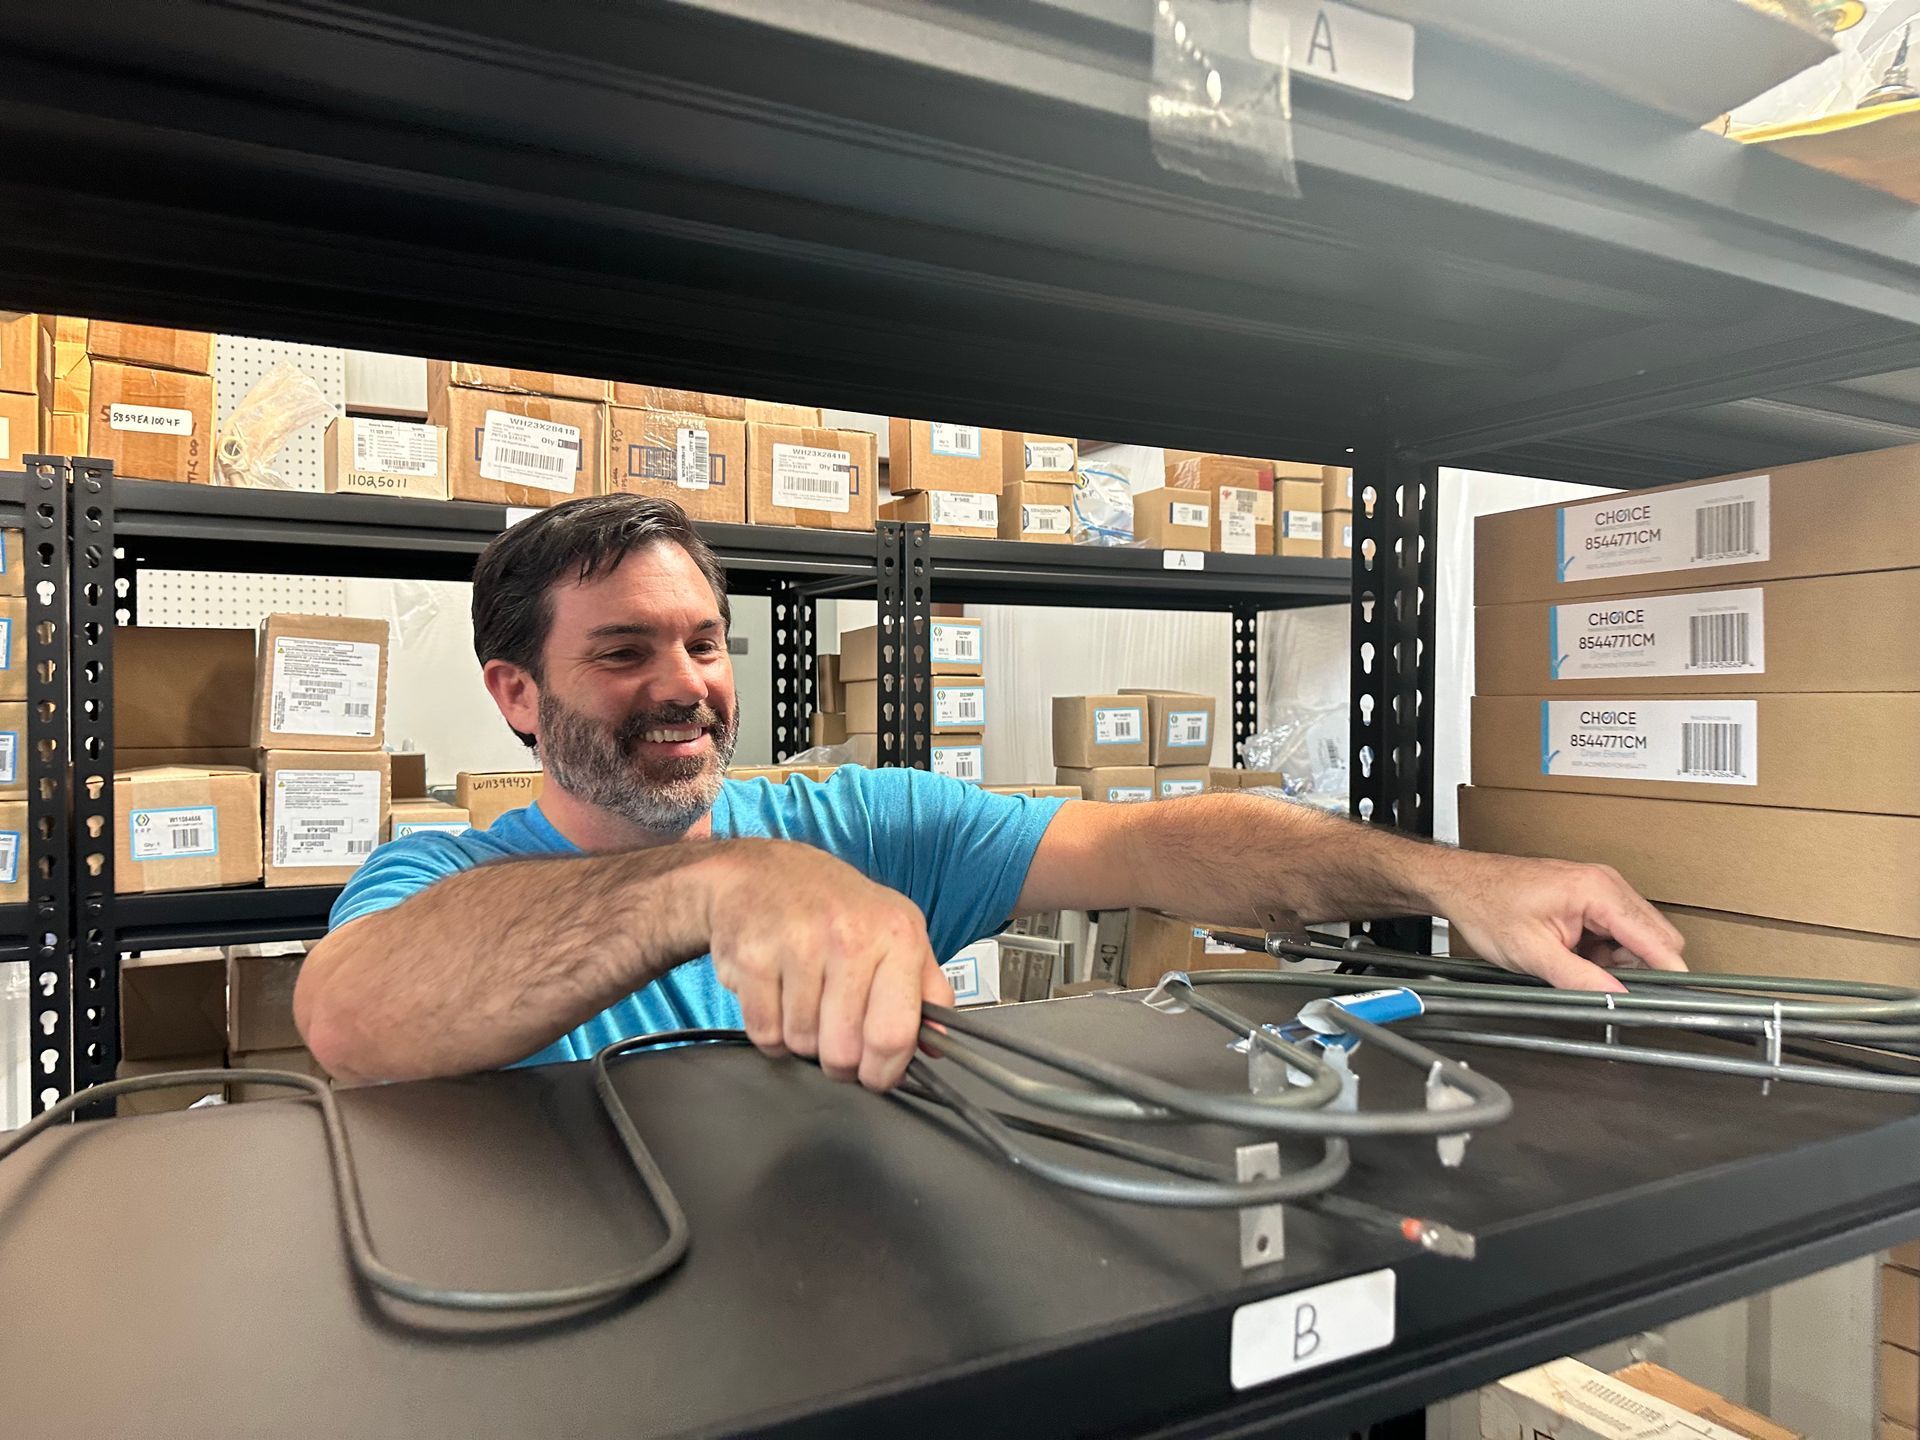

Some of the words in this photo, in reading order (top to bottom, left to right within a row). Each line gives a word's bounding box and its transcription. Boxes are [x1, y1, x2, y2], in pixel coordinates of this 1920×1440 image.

[1307, 8, 1338, 73] A
[348, 473, 407, 488] 11025011
[1595, 505, 1651, 525] CHOICE
[1585, 528, 1662, 550] 8544771CM
[1178, 554, 1187, 566] A
[1588, 609, 1645, 626] CHOICE
[1579, 633, 1656, 650] 8544771CM
[1580, 711, 1637, 725] CHOICE
[1570, 734, 1648, 749] 8544771CM
[1294, 1303, 1320, 1361] B
